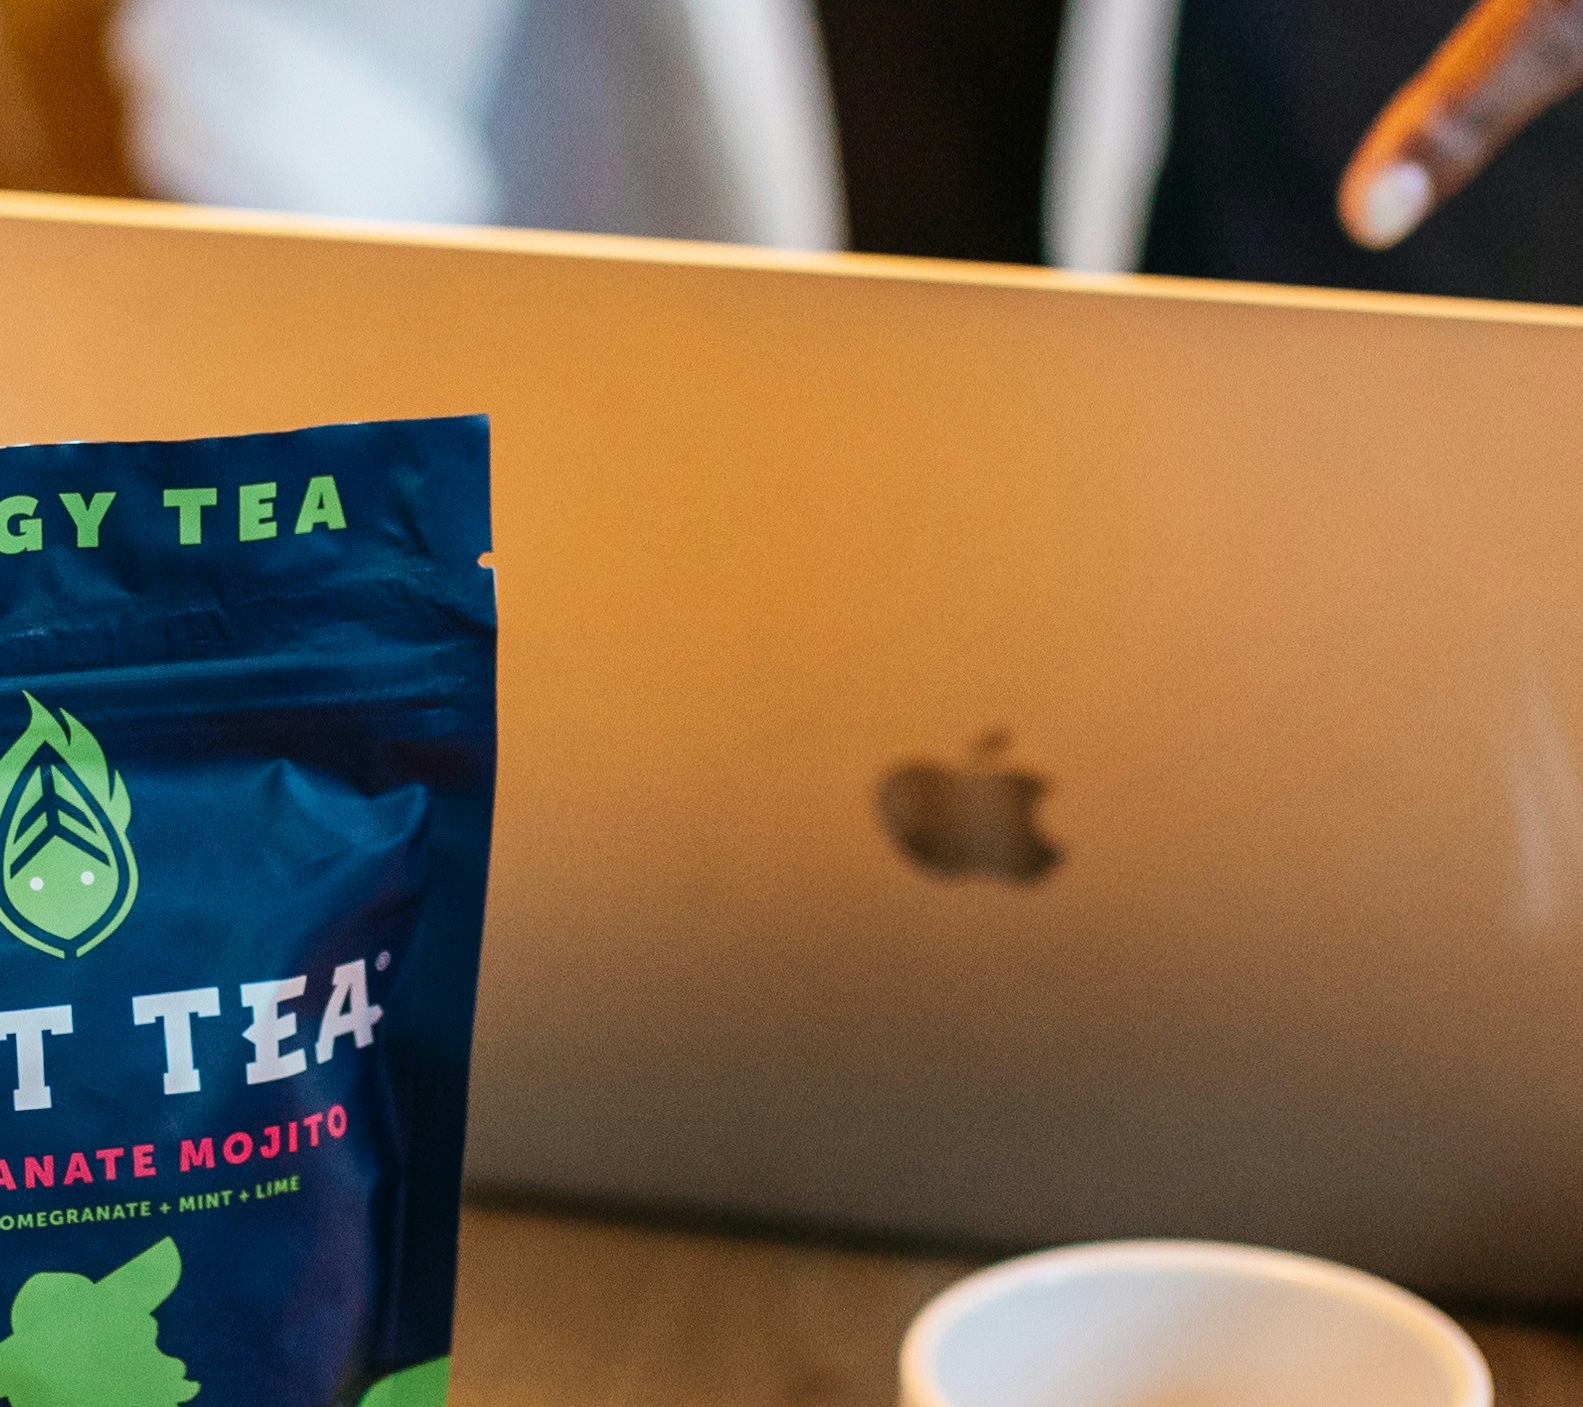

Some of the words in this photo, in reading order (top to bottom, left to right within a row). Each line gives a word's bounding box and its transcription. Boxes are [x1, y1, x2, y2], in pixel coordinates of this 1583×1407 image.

[163, 476, 348, 546] TEA
[178, 1103, 348, 1173] MOJITO
[179, 1190, 233, 1213] MINT
[255, 1175, 301, 1200] LIME
